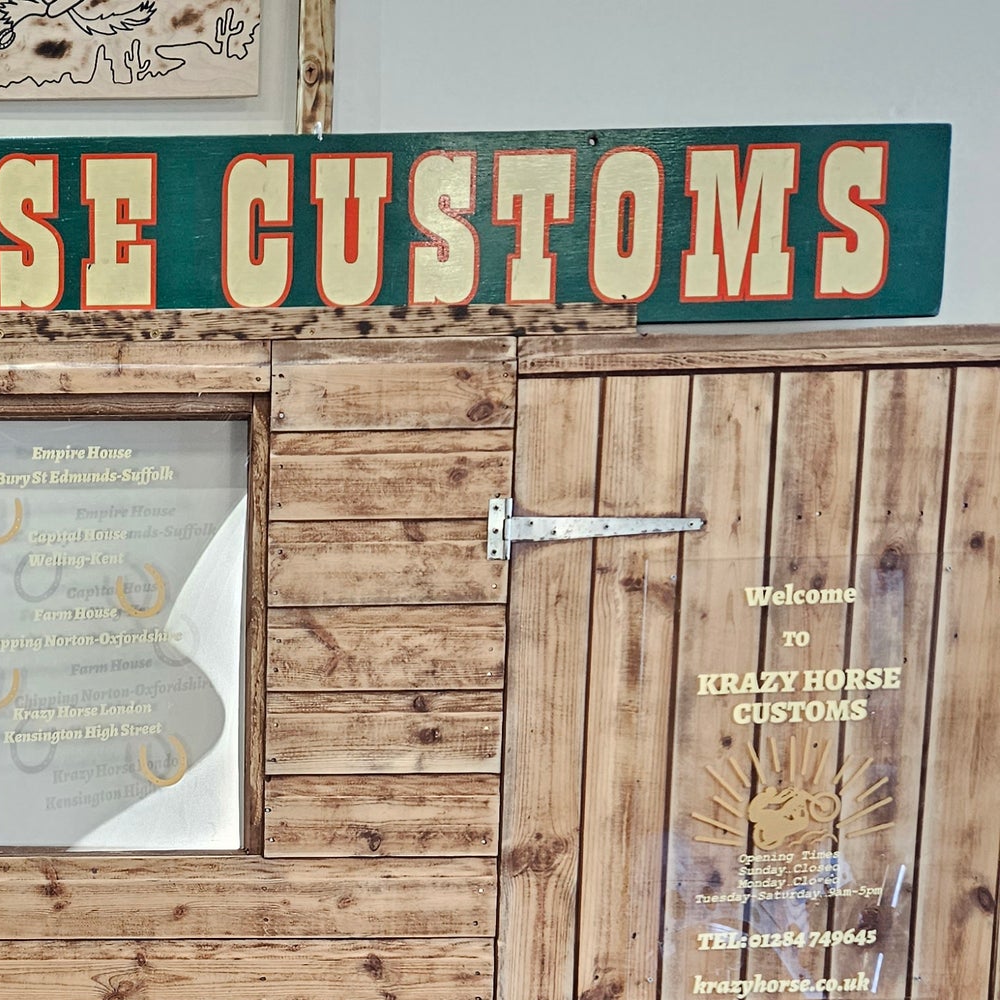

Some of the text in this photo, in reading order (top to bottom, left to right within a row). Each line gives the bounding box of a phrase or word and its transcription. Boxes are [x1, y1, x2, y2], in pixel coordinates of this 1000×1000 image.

[222, 141, 890, 307] CUSTOMS
[31, 446, 133, 463] Empire House
[32, 471, 48, 484] St
[49, 466, 175, 485] Edmunds-Suffolk
[28, 529, 128, 550] Capital House
[28, 552, 125, 570] Welling-Kent
[744, 583, 857, 607] Welcome
[33, 608, 118, 622] Farm House
[43, 629, 183, 647] Norton-Oxfordshire
[782, 631, 811, 647] TO
[696, 667, 902, 695] KRAZY HORSE
[13, 702, 153, 723] Krazy Horse London
[732, 699, 868, 725] CUSTOMS
[3, 722, 163, 745] Kensington High Street
[737, 850, 840, 866] Opening Times
[748, 930, 807, 949] 01284
[808, 928, 877, 948] 749645
[692, 971, 870, 1000] krazyhorse.co.uk
